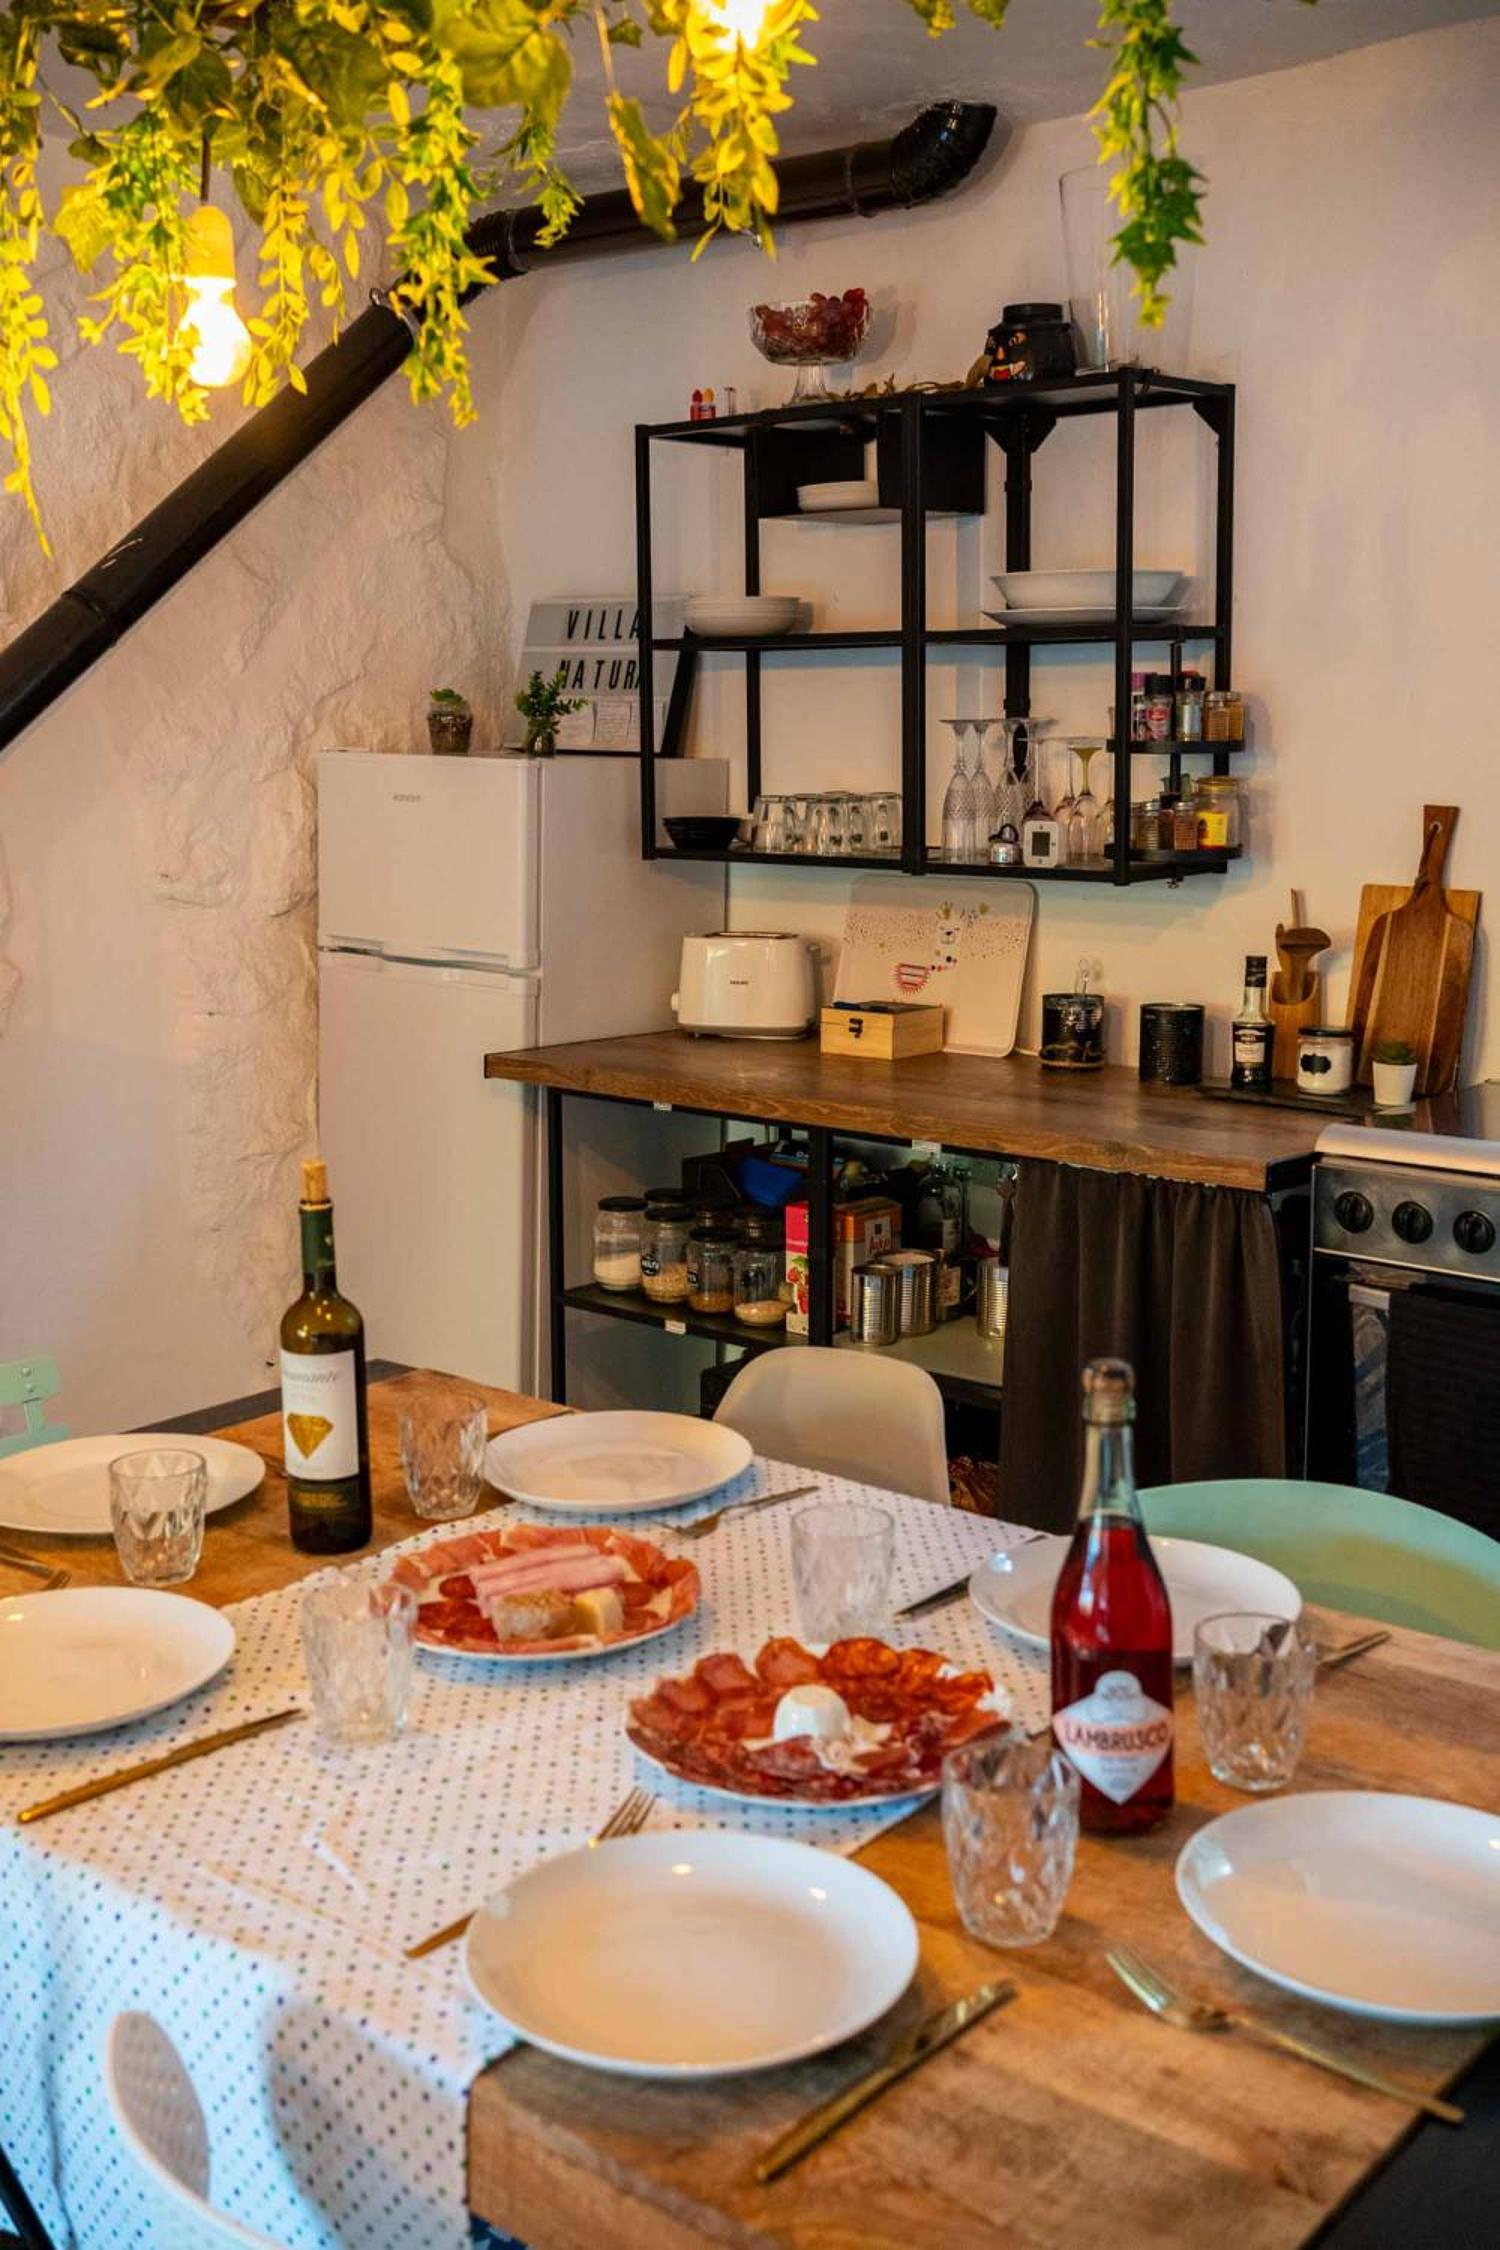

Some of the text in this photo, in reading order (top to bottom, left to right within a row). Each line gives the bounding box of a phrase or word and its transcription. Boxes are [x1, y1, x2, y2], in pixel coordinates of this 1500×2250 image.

[567, 609, 640, 639] VILLA
[559, 659, 641, 690] NATUR
[1065, 1722, 1168, 1751] LAMBRUSCO
